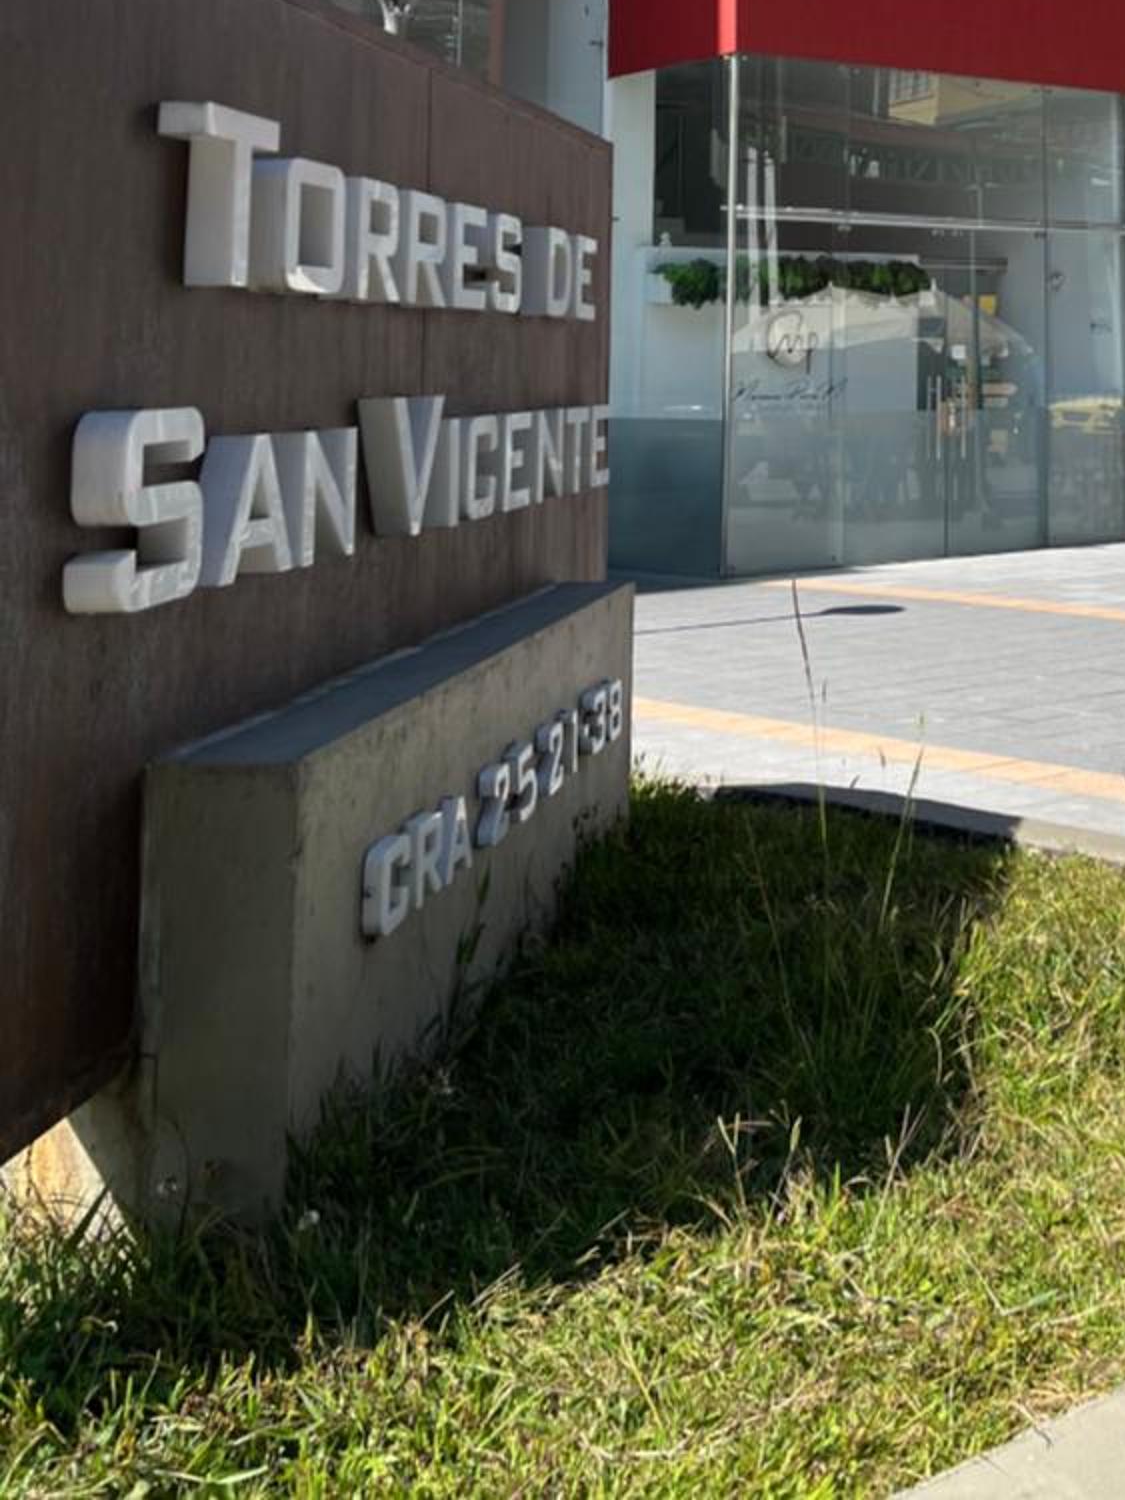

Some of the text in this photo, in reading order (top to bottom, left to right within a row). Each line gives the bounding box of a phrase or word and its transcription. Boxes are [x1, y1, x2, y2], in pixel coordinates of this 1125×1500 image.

[158, 101, 598, 321] TORRES DE
[63, 395, 610, 614] SAN VICENTE
[362, 796, 473, 937] CRA
